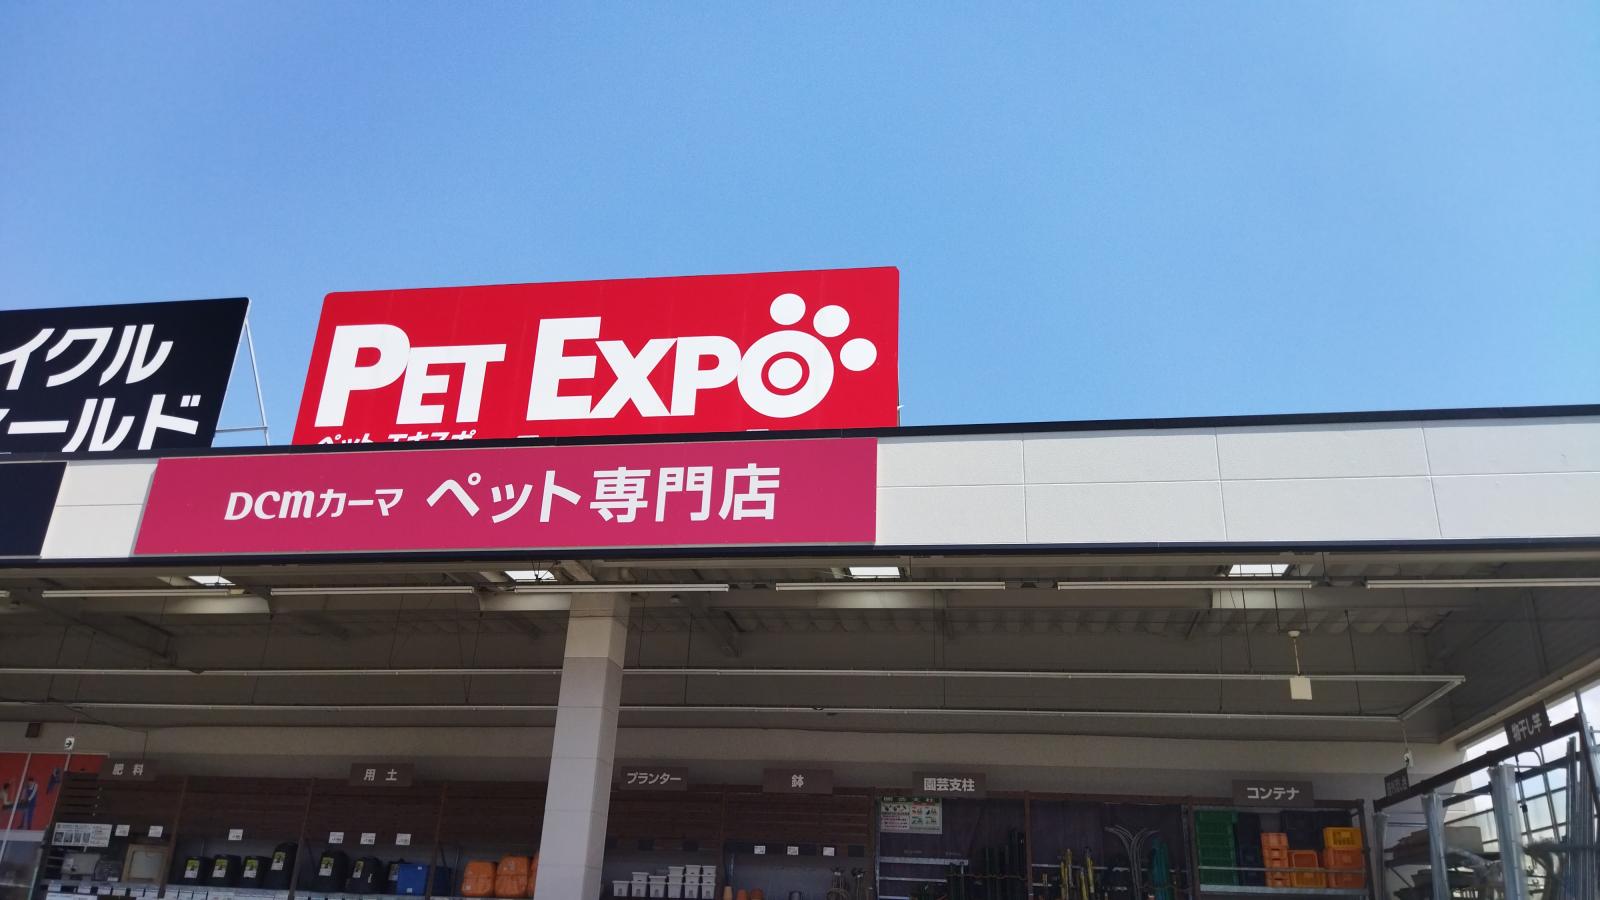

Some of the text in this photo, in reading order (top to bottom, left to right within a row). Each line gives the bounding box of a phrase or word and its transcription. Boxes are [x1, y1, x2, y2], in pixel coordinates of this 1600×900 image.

[315, 317, 836, 428] PET EXPO
[0, 393, 202, 453] ールド
[426, 462, 781, 524] ペット専門店
[791, 774, 805, 788] 鉢
[923, 777, 975, 792] 園芸支柱
[1246, 786, 1299, 800] コンテナ
